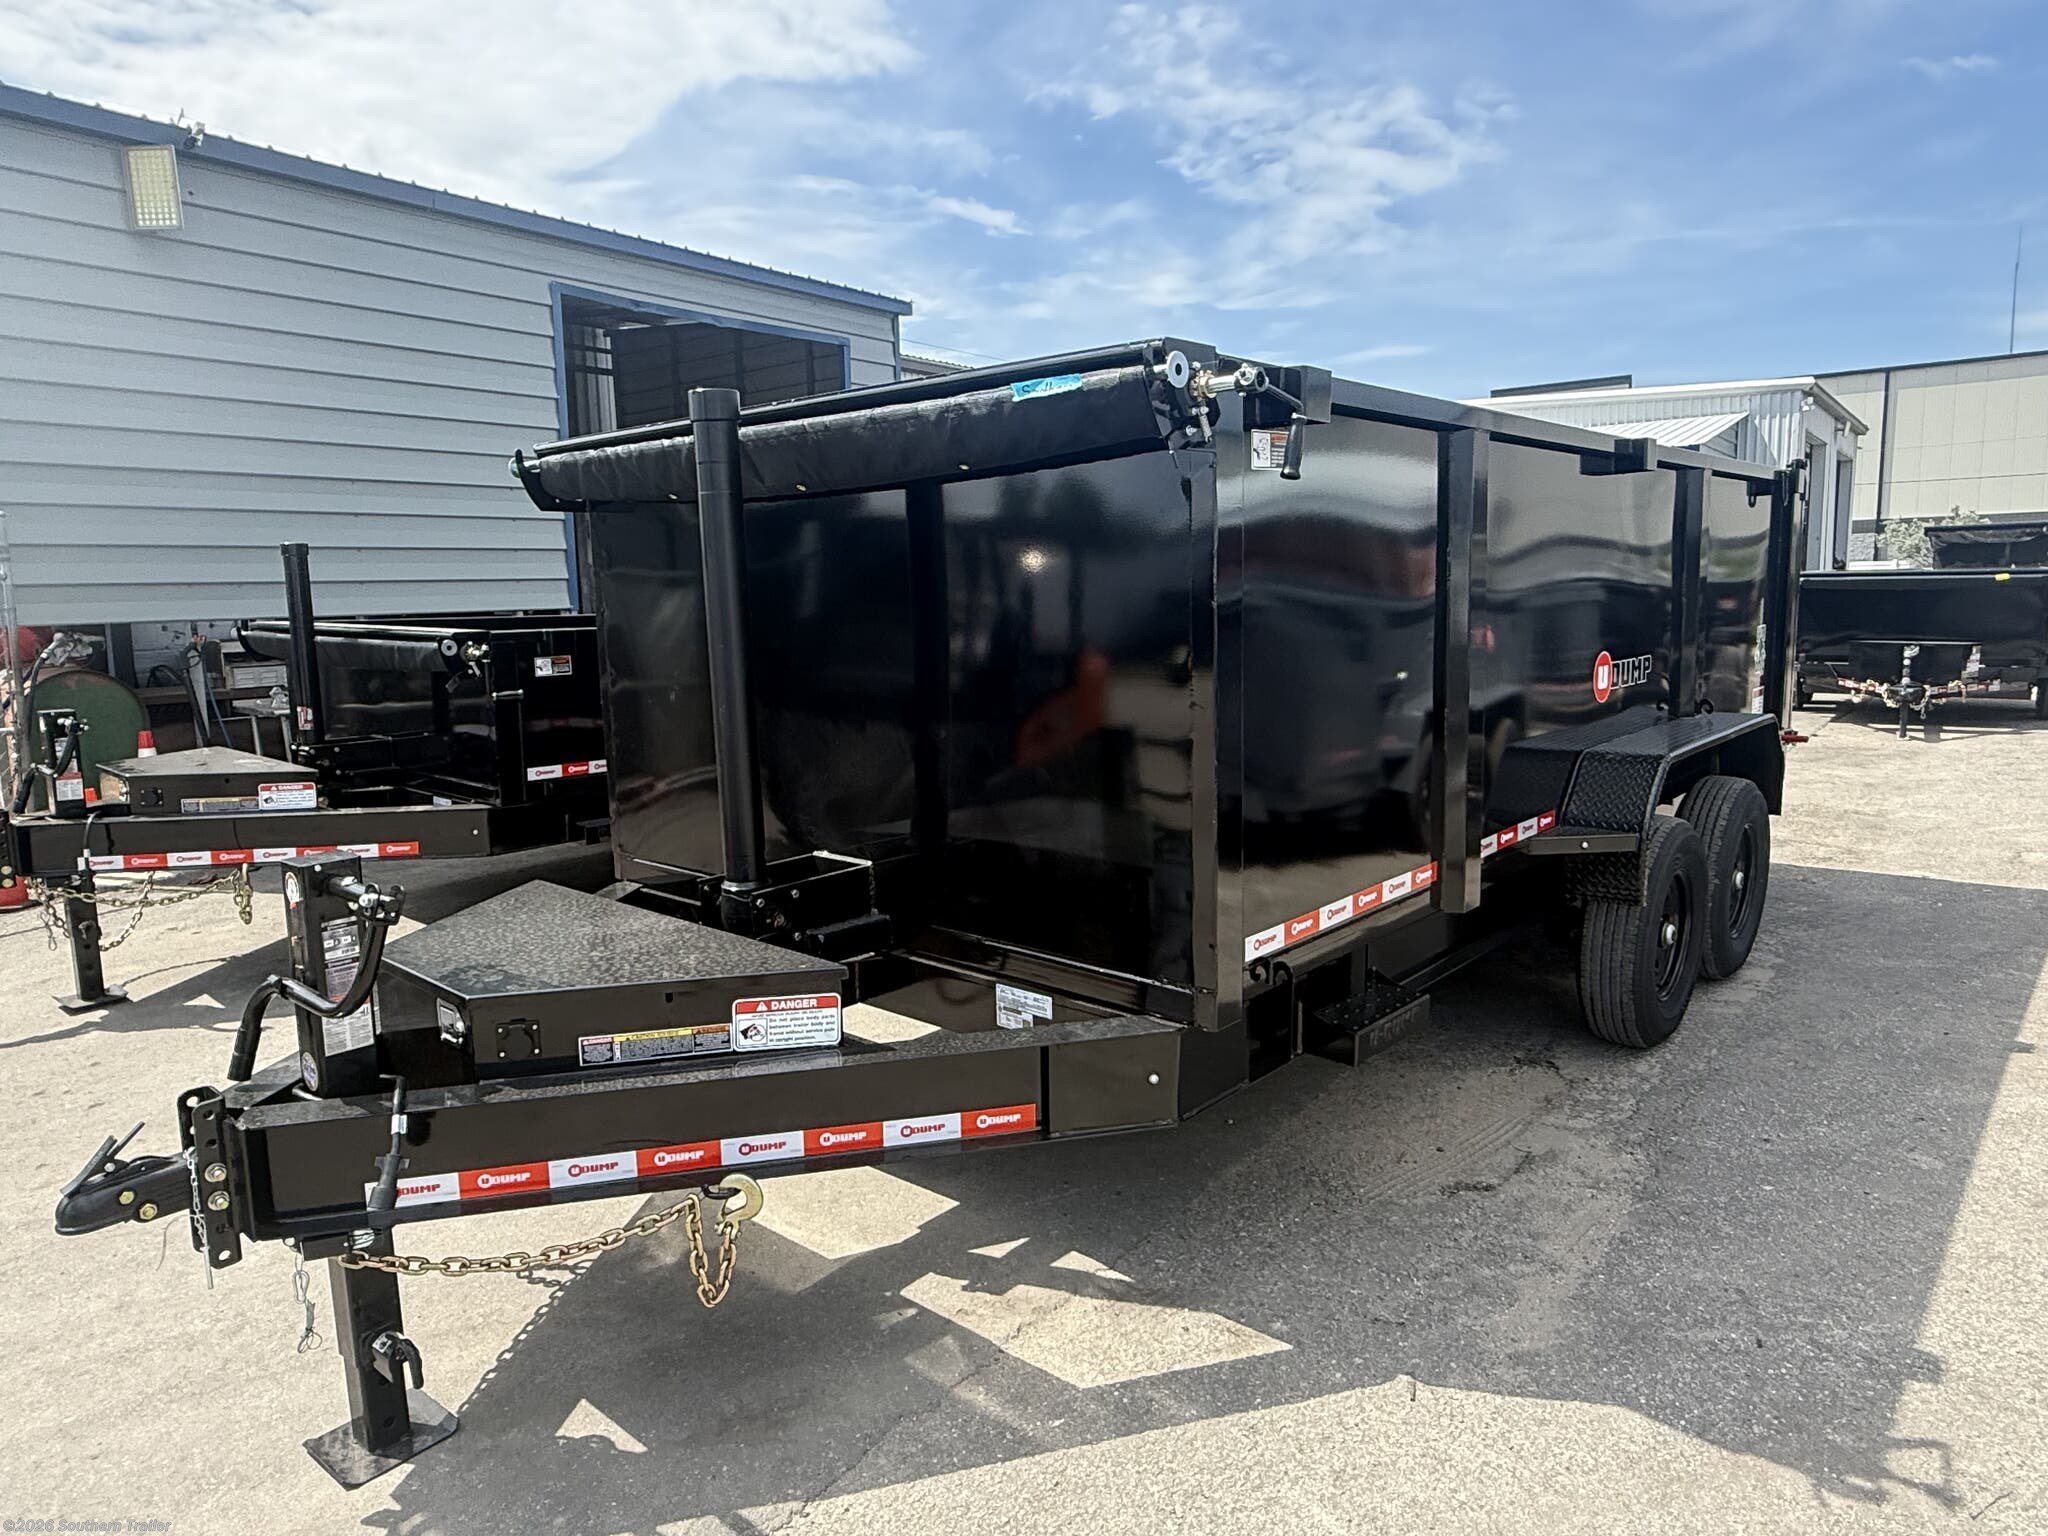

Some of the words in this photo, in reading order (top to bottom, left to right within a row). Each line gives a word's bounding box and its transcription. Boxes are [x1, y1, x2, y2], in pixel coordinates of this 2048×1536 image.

[771, 999, 818, 1010] DANGER
[397, 1183, 441, 1198] DUMP
[568, 1161, 619, 1177] UDUMP
[738, 1141, 787, 1156] UDUMP
